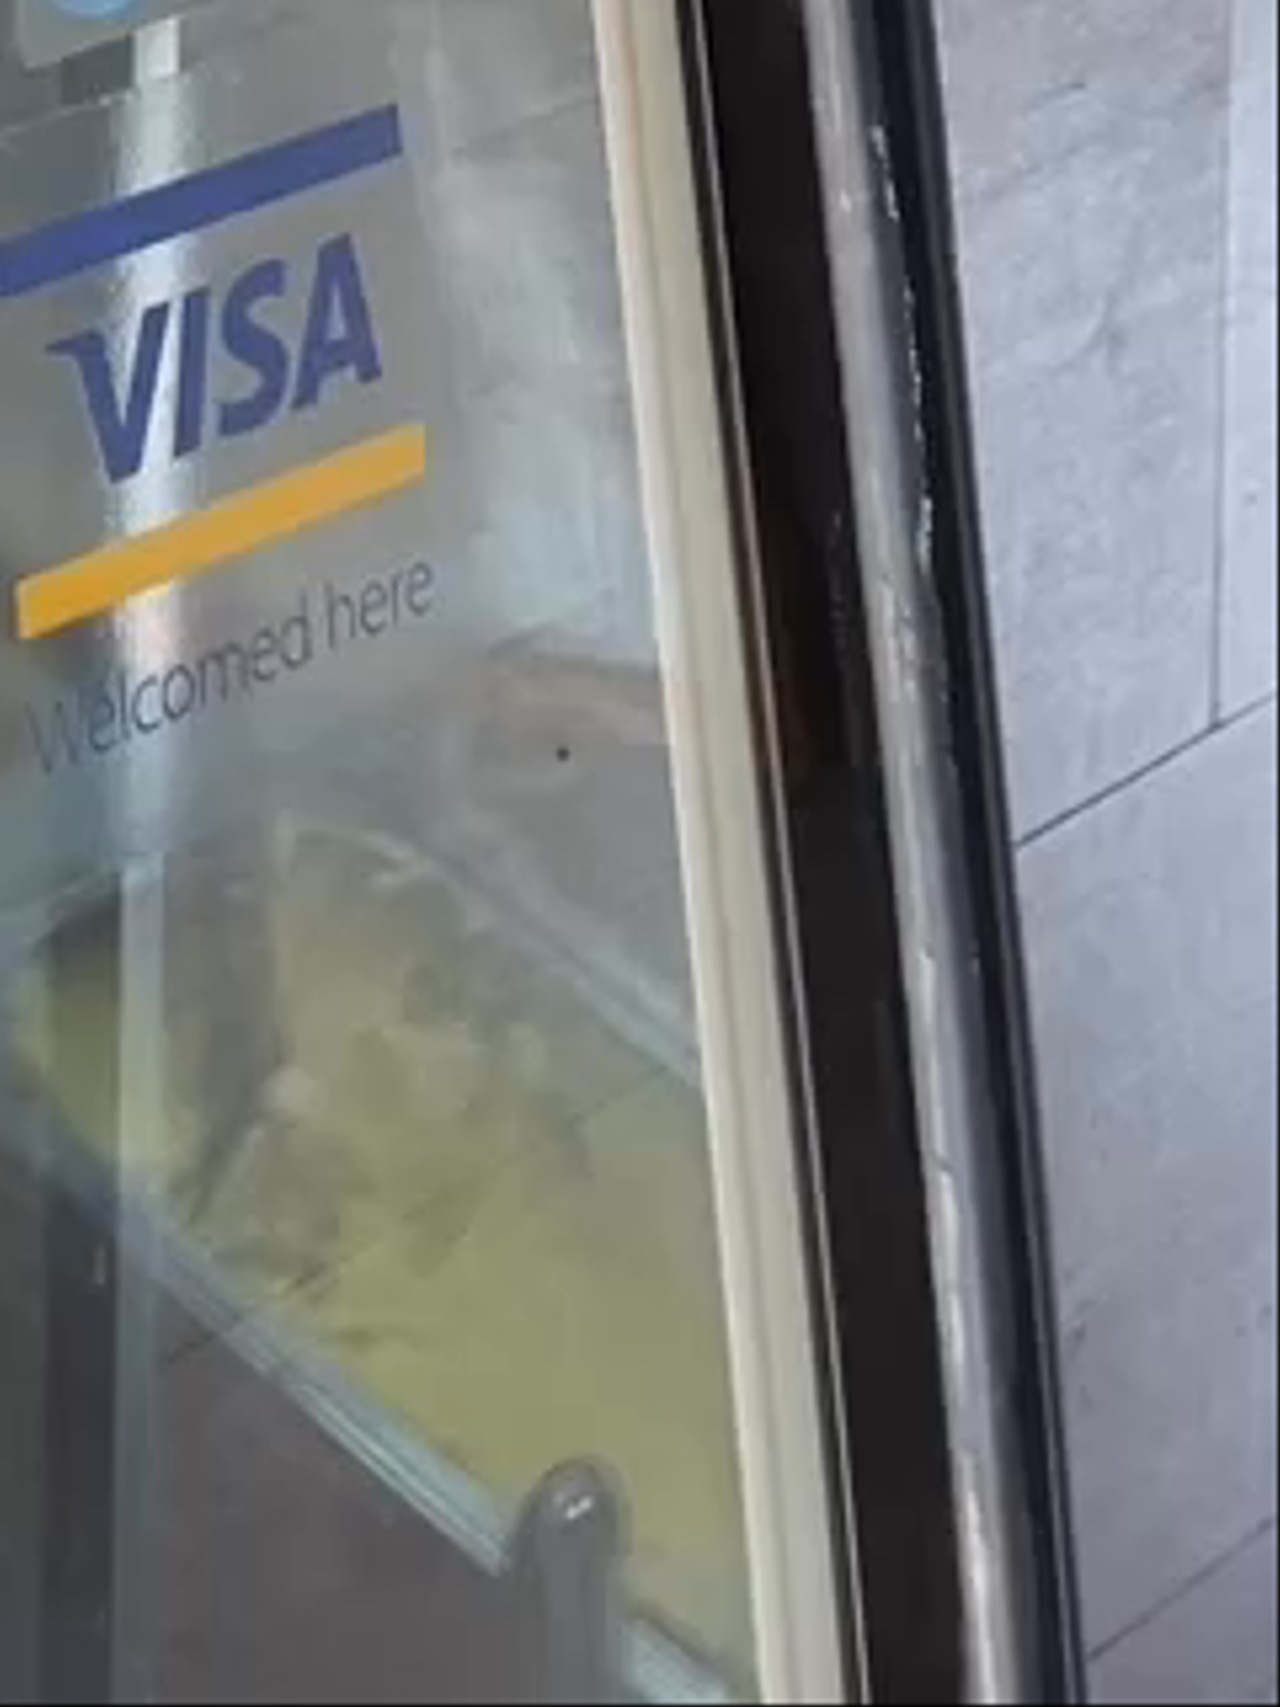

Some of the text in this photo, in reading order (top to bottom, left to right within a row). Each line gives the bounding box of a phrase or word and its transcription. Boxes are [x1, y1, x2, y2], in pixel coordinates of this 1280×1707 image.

[44, 233, 384, 483] VISA
[32, 553, 440, 776] Welcomed here
